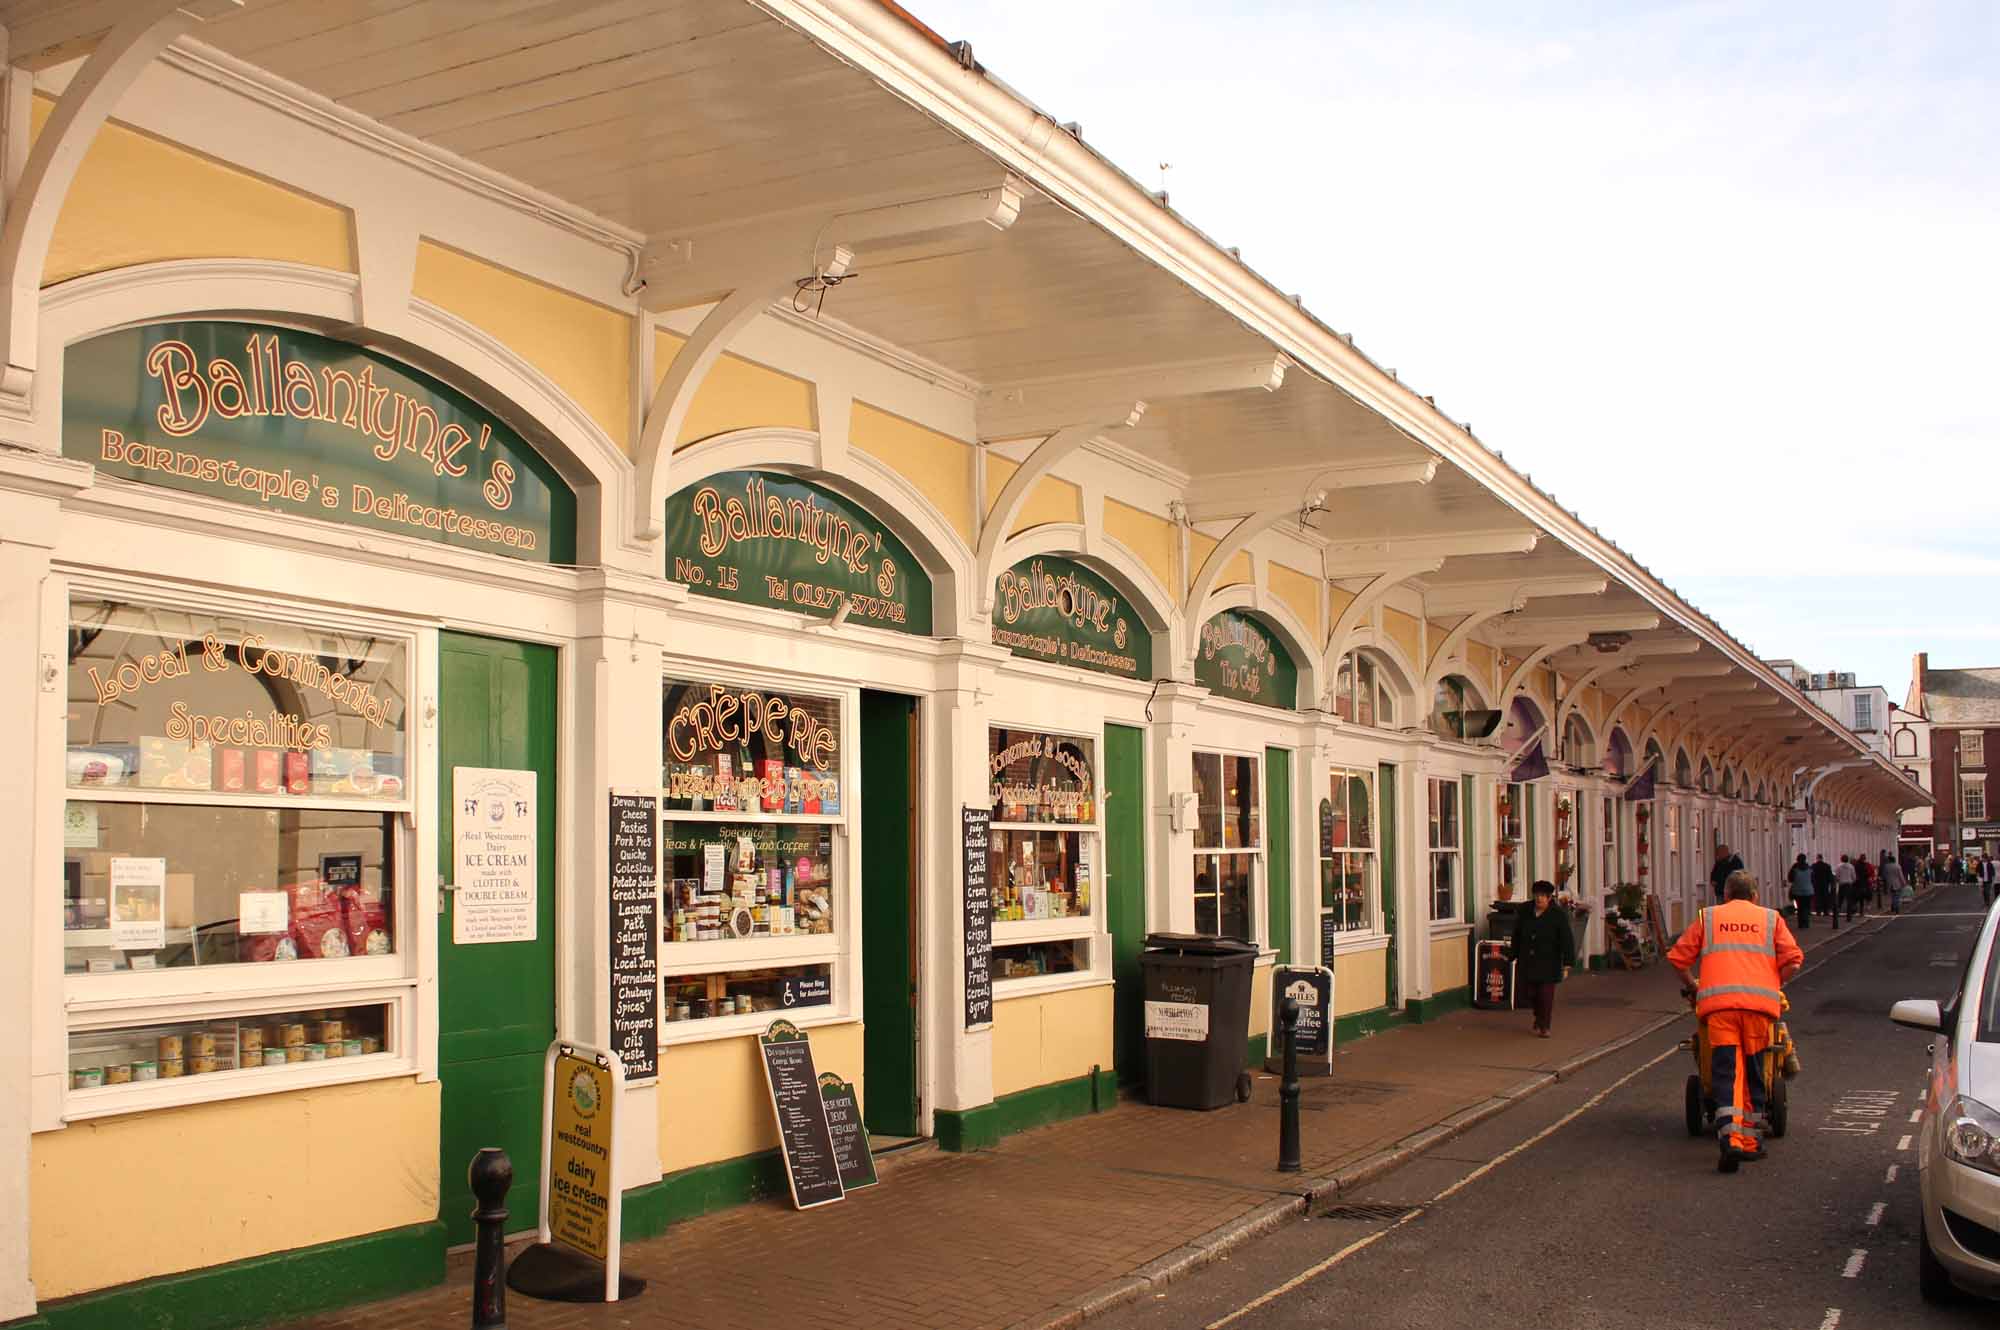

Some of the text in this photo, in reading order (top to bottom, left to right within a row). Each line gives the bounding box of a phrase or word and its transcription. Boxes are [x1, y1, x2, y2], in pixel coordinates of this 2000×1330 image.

[147, 333, 517, 511] Ballantyne's
[101, 428, 538, 551] Barnstaple's Delicatessen
[694, 477, 896, 597] Ballantyne's
[675, 556, 712, 586] No.
[718, 565, 739, 591] 15
[765, 575, 789, 601] Tel
[850, 593, 906, 624] 379742
[1071, 641, 1137, 672] Delicatessen
[88, 633, 393, 728] Local & Continental
[1220, 660, 1238, 691] The
[166, 701, 332, 752] Specialities
[612, 797, 656, 809] Devon Ham
[622, 810, 648, 820] Cheese
[619, 821, 648, 834] Pasties
[615, 834, 652, 848] Pork Pies
[665, 838, 687, 850] Teas
[690, 839, 697, 850] &
[776, 840, 809, 853] Coffee
[465, 854, 528, 867] ICE CREAM
[620, 848, 647, 861] Quiche
[968, 848, 985, 864] Honey
[615, 863, 654, 874] Coleslaw
[612, 875, 657, 889] Potato Salad
[499, 890, 528, 900] CREAM
[612, 887, 657, 901] Greek Salad
[967, 887, 987, 898] Cream
[618, 903, 652, 920] Lasagne
[970, 915, 985, 927] Teas
[1719, 922, 1759, 934] NDDC
[616, 930, 648, 944] Salami
[622, 943, 646, 957] Bread
[614, 955, 656, 970] Local Jam
[972, 956, 986, 970] Nuts
[613, 970, 656, 986] Marmalade
[618, 987, 653, 1002] Chutney
[1289, 992, 1315, 1001] MILES
[616, 1001, 645, 1017] Spices
[1304, 1008, 1320, 1018] Tea
[614, 1017, 654, 1035] Vinegars
[1296, 1017, 1321, 1028] offee
[624, 1035, 643, 1048] Oils
[618, 1048, 645, 1061] Pasta
[622, 1060, 653, 1075] Drinks
[575, 1122, 592, 1138] real
[558, 1131, 609, 1160] westcountry
[568, 1156, 596, 1187] dairy
[554, 1173, 570, 1195] ice
[572, 1182, 608, 1211] cream
